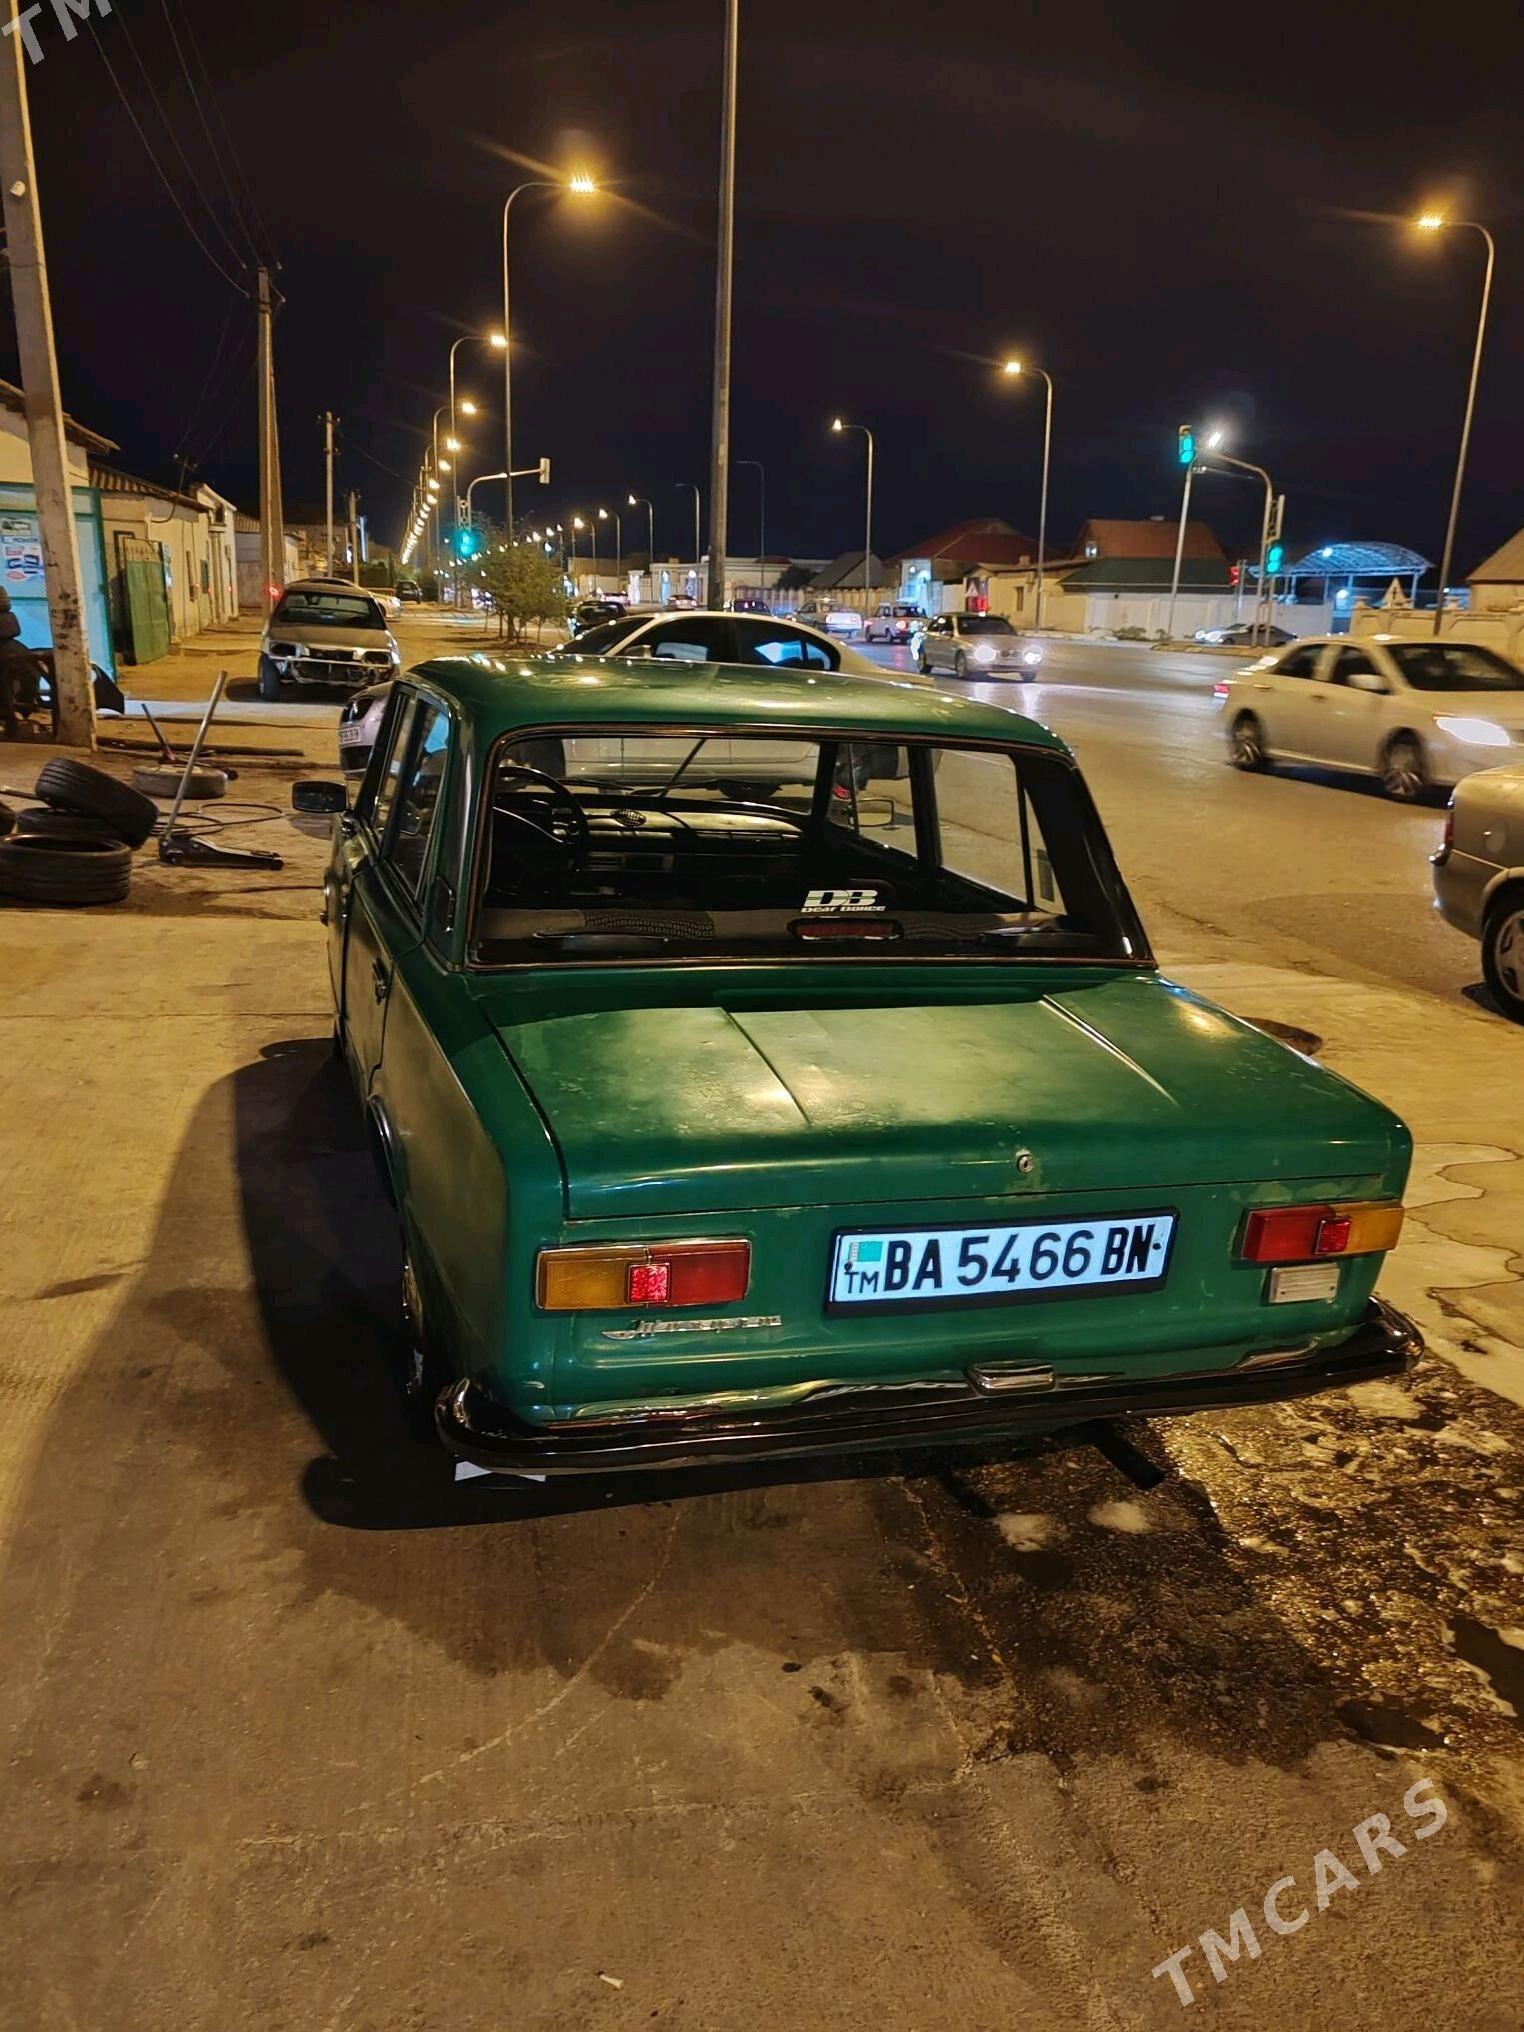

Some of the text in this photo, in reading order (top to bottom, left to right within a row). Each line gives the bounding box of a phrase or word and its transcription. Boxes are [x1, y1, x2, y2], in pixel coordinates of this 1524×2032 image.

[804, 889, 878, 907] DB
[883, 1224, 1155, 1292] BA 5466 BN
[844, 1270, 878, 1294] TM
